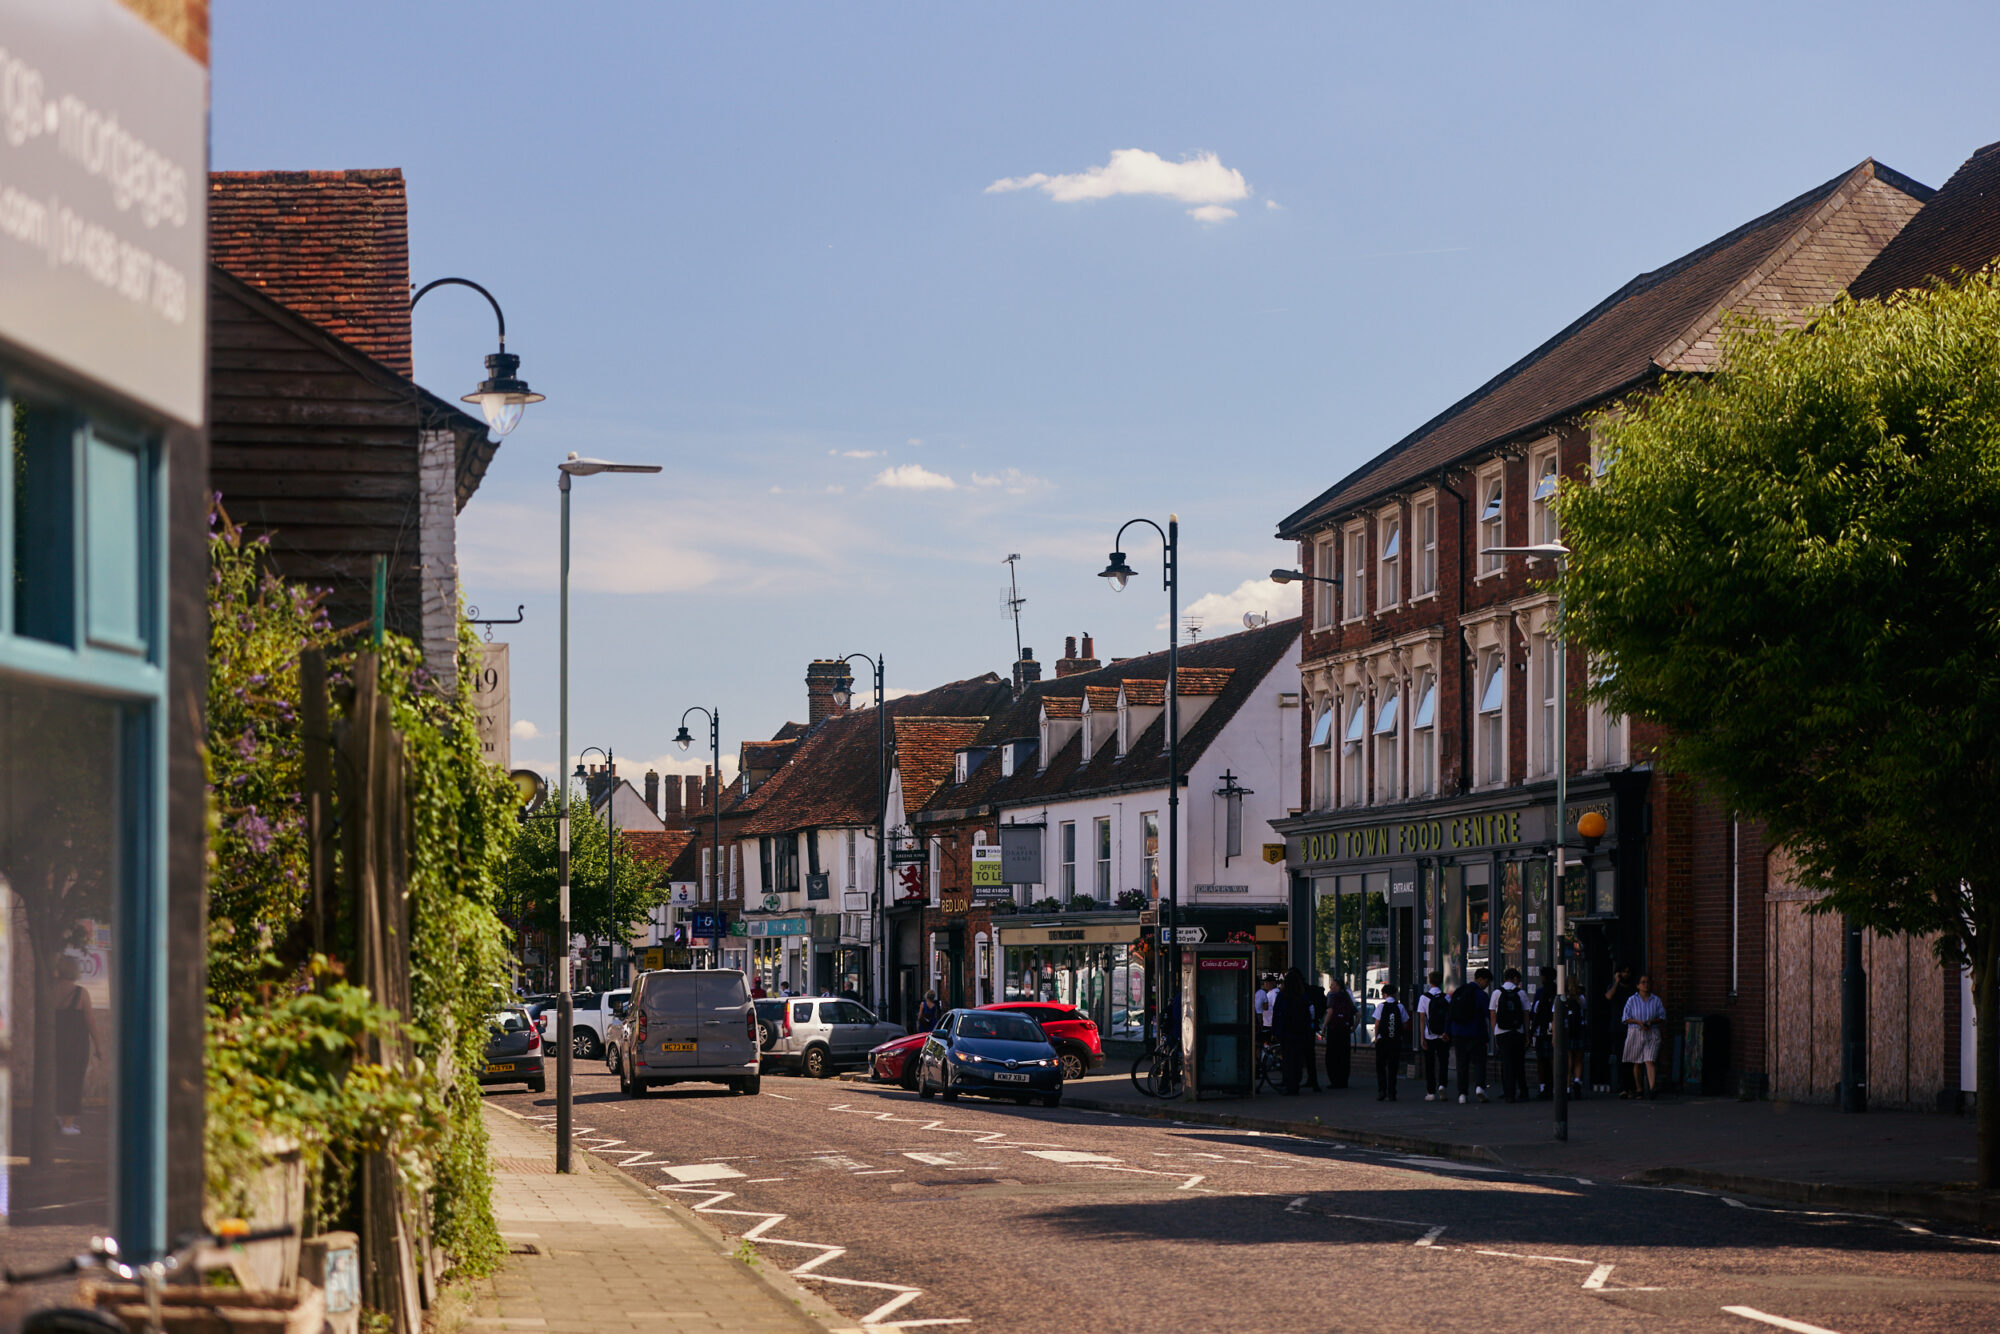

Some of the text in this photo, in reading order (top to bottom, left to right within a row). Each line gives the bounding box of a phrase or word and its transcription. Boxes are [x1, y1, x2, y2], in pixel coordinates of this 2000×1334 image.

[1312, 812, 1520, 861] OLD TOWN FOOD CENTRE
[976, 872, 1002, 881] TO LE
[1232, 885, 1247, 893] WAY
[1393, 882, 1414, 894] ENTRANCE
[942, 898, 969, 913] RED LION
